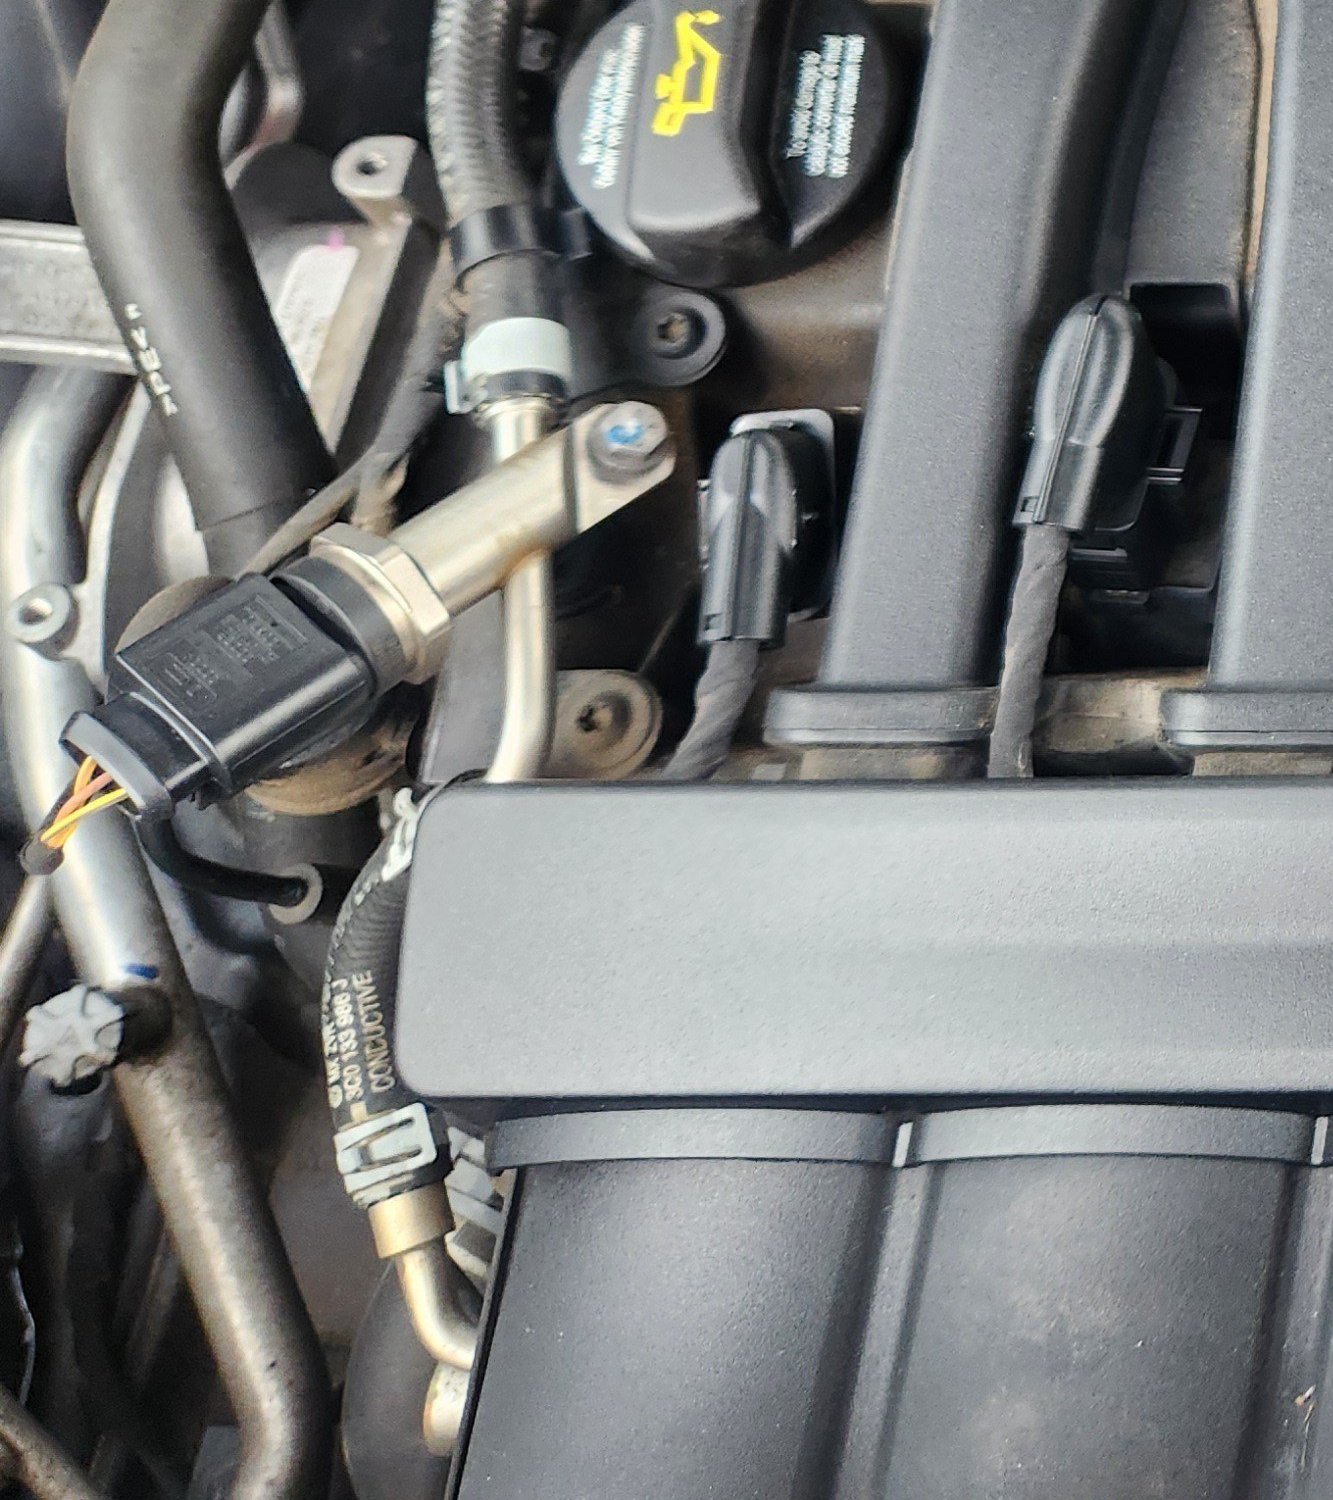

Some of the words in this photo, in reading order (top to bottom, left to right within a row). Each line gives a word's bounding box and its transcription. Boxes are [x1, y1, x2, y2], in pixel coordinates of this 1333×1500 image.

[794, 67, 822, 108] damage
[812, 78, 837, 128] converter
[833, 64, 861, 114] maximum
[803, 128, 831, 176] catalytic
[829, 115, 854, 156] exceed
[352, 970, 395, 1093] CONDUCTIVE
